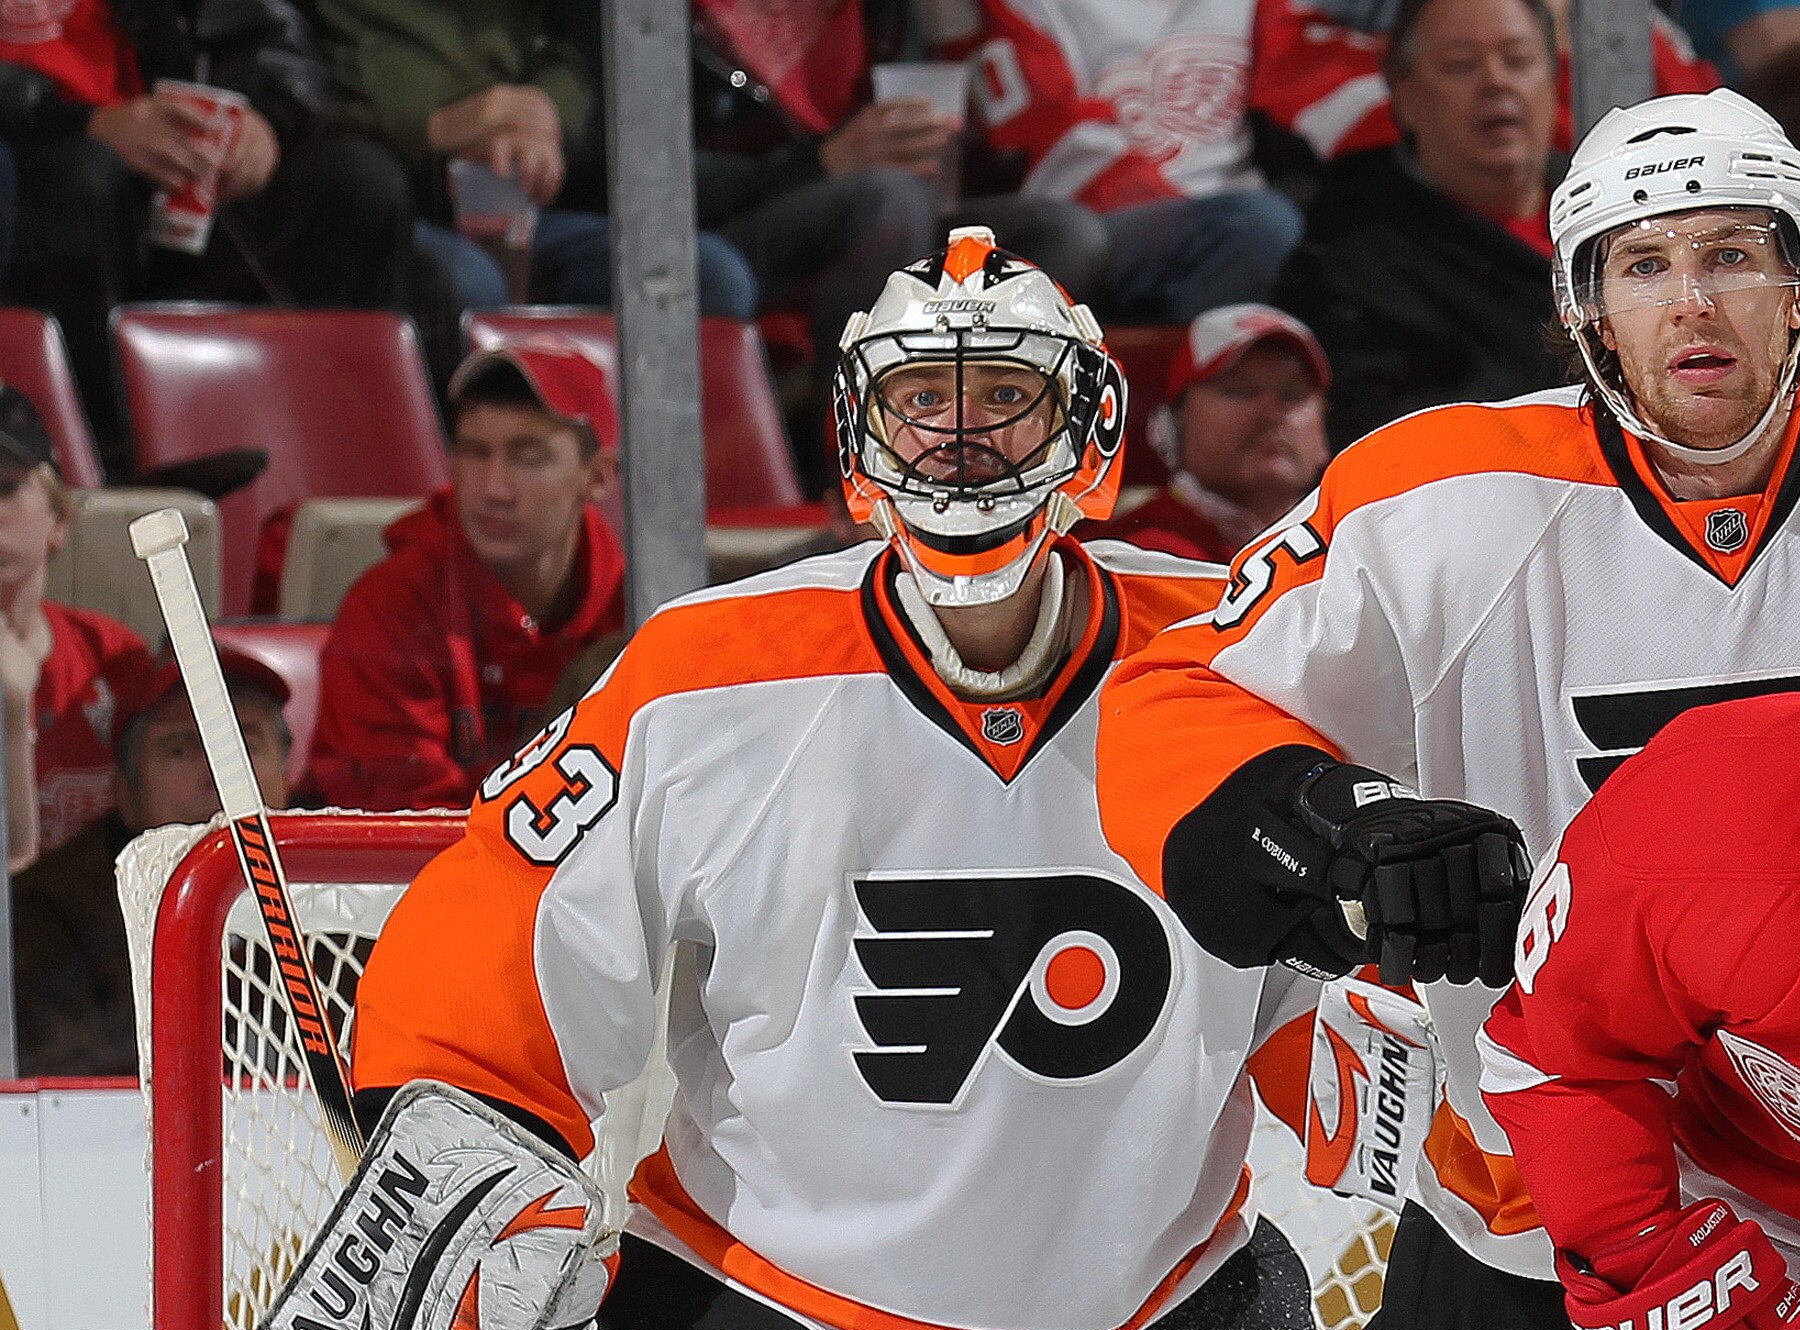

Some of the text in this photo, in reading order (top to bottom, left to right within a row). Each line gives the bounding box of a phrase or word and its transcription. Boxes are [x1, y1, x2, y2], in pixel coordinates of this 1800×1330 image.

[1624, 154, 1706, 181] BAUER
[922, 301, 996, 315] BAUER
[1715, 517, 1740, 544] NHL
[991, 717, 1017, 738] NHL
[1370, 1034, 1409, 1196] VAUGHN
